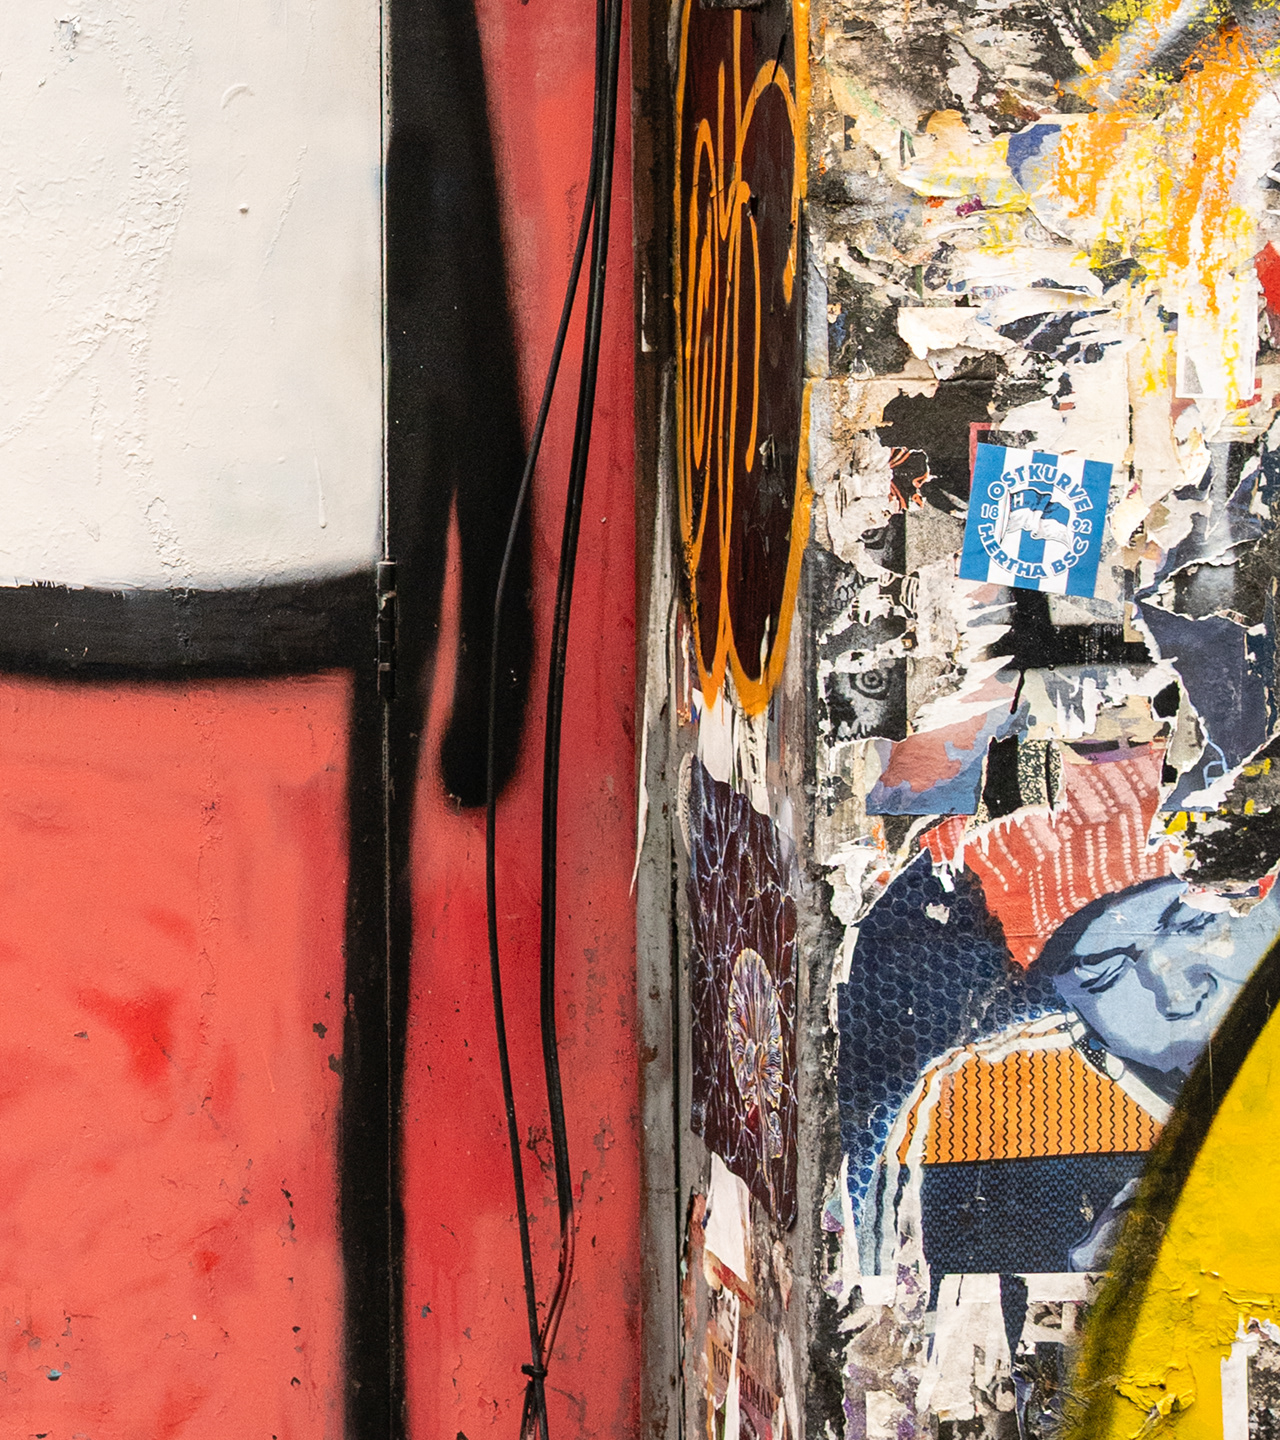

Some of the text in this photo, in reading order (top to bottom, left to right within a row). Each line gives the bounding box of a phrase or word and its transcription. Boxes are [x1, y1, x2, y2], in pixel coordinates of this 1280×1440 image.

[987, 463, 1094, 515] OSTKURVE
[980, 503, 1000, 520] 18
[1072, 517, 1093, 535] 92
[978, 523, 1089, 579] HERTHA BSC
